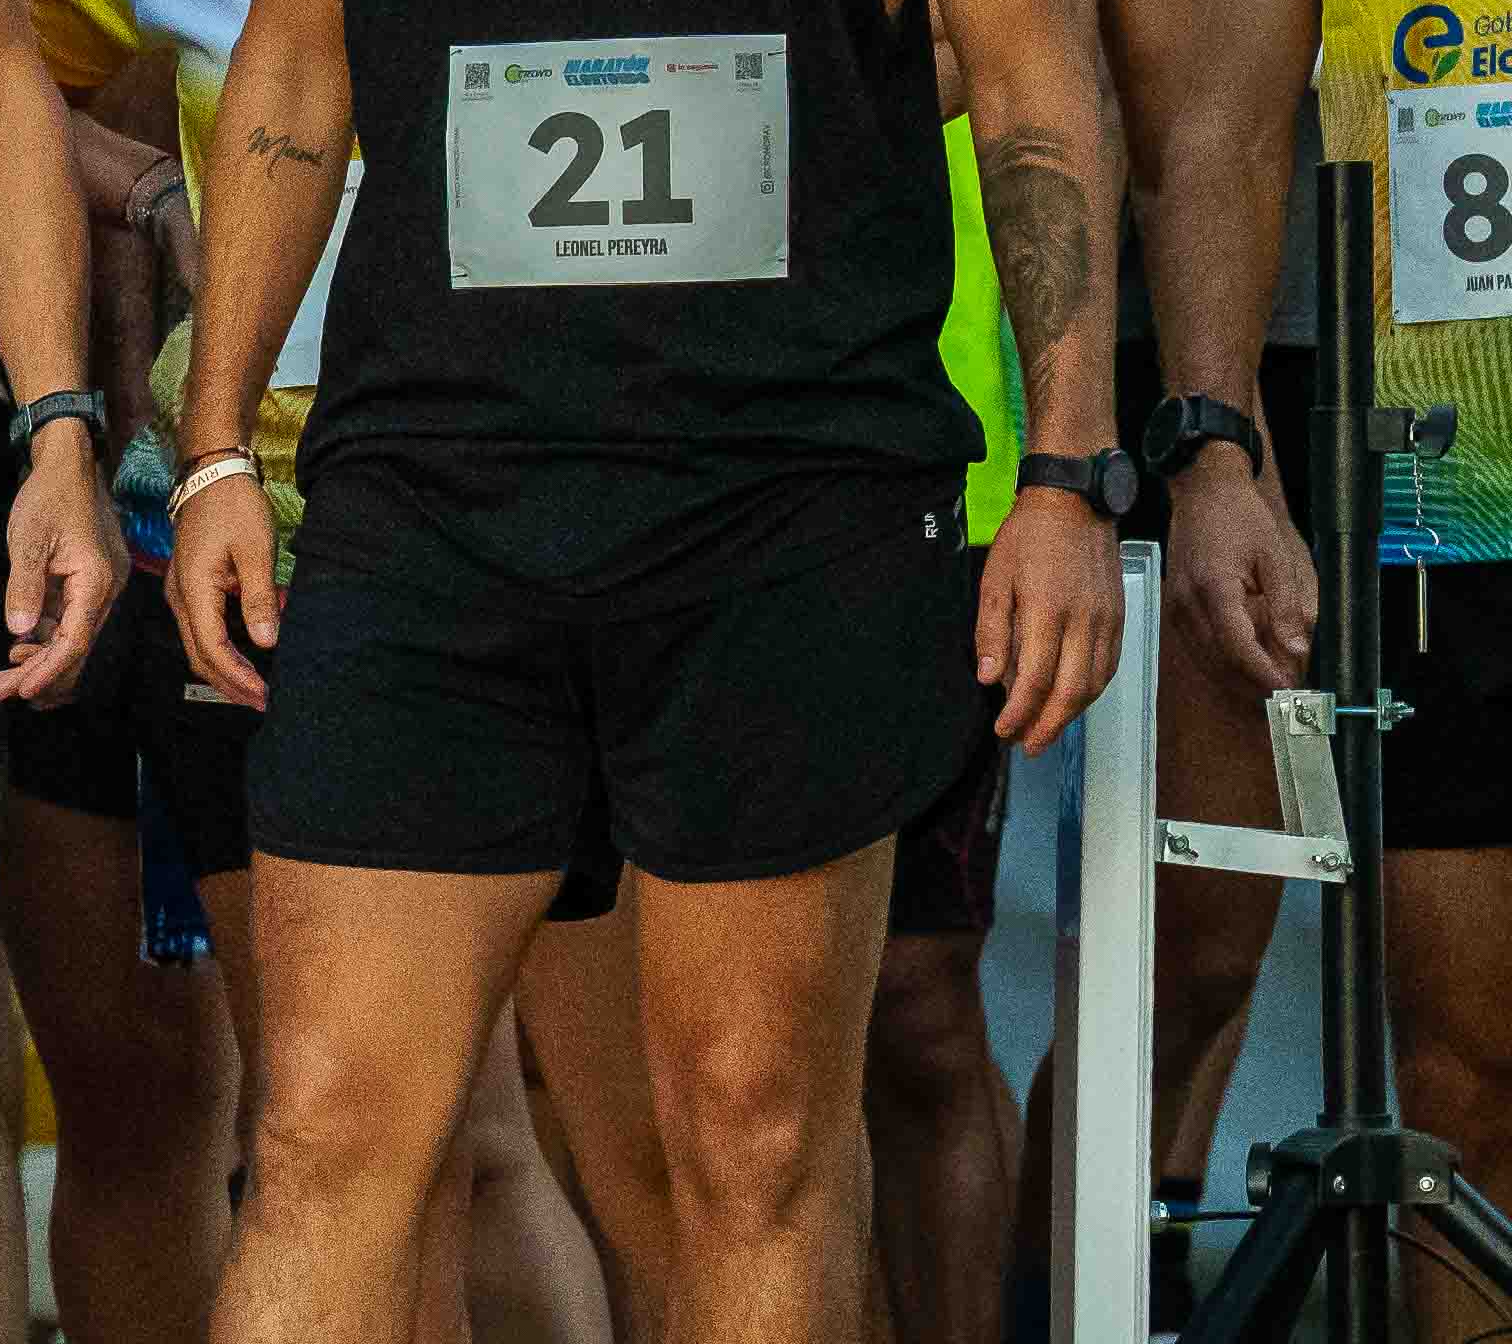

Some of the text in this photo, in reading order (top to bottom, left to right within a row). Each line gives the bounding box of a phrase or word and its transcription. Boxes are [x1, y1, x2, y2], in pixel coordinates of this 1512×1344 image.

[527, 109, 694, 227] 21
[555, 238, 669, 258] LEONEL PEREYRA
